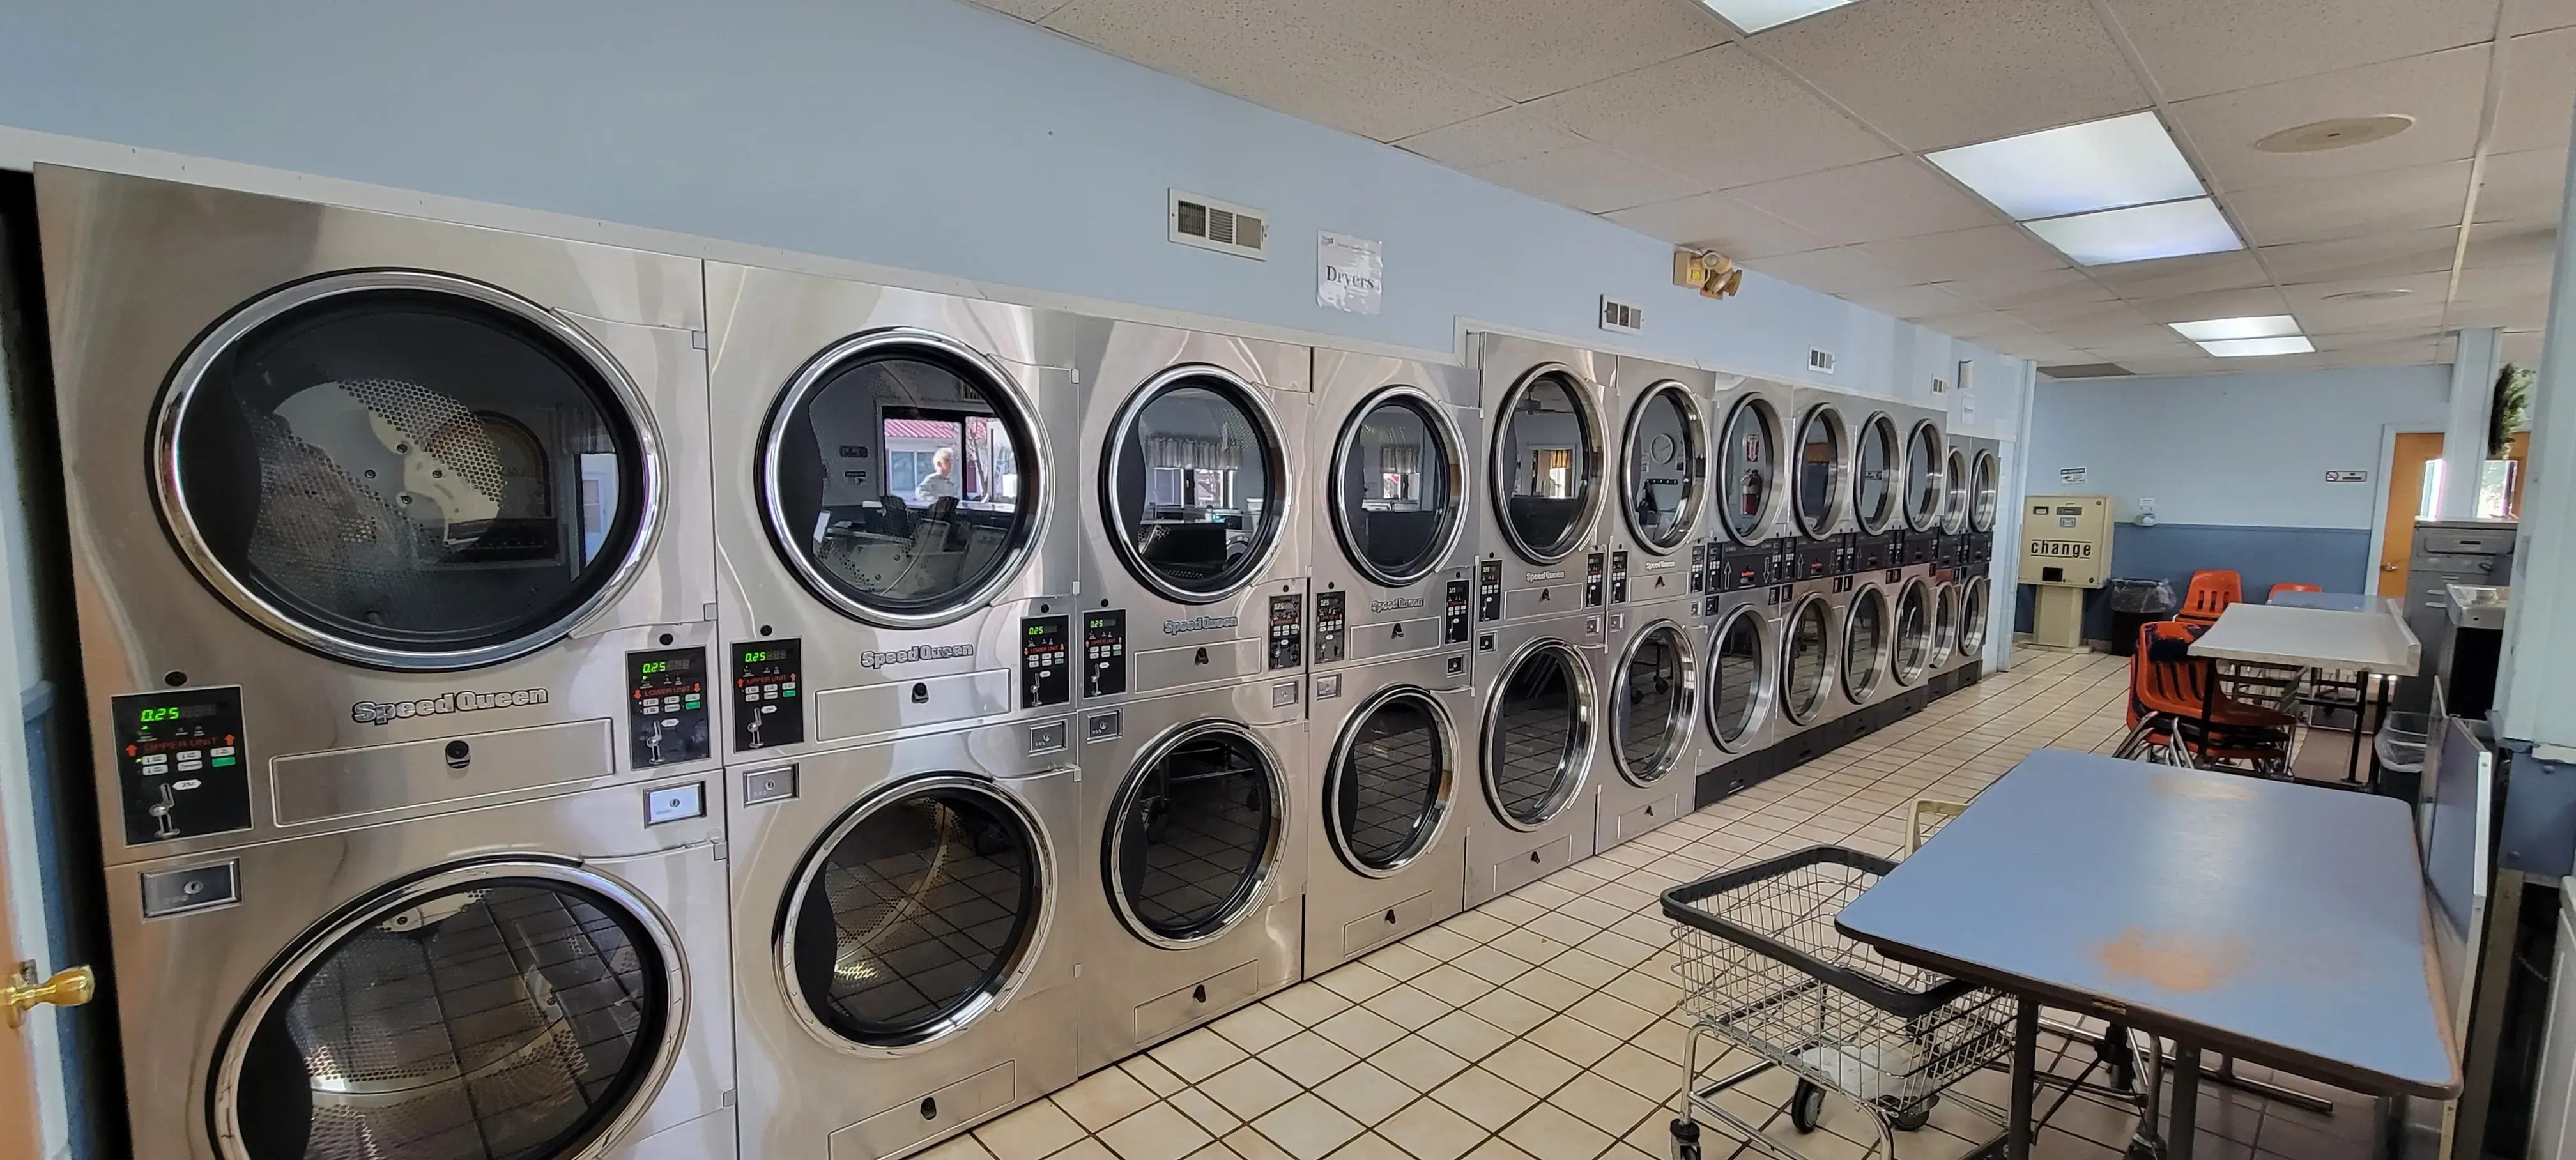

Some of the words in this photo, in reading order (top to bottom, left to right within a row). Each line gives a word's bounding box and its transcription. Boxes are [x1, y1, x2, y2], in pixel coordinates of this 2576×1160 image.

[1326, 265, 1374, 289] Dryers
[2030, 540, 2092, 558] change
[1163, 617, 1202, 636] Speed
[744, 652, 766, 662] 0.25
[861, 644, 919, 669] Speed
[919, 642, 974, 659] Queen
[643, 662, 666, 673] 0.25
[140, 706, 180, 722] 0.25
[352, 692, 456, 726] Speed
[455, 687, 549, 712] Queen
[144, 740, 187, 751] UPPER
[190, 736, 218, 747] UNIT
